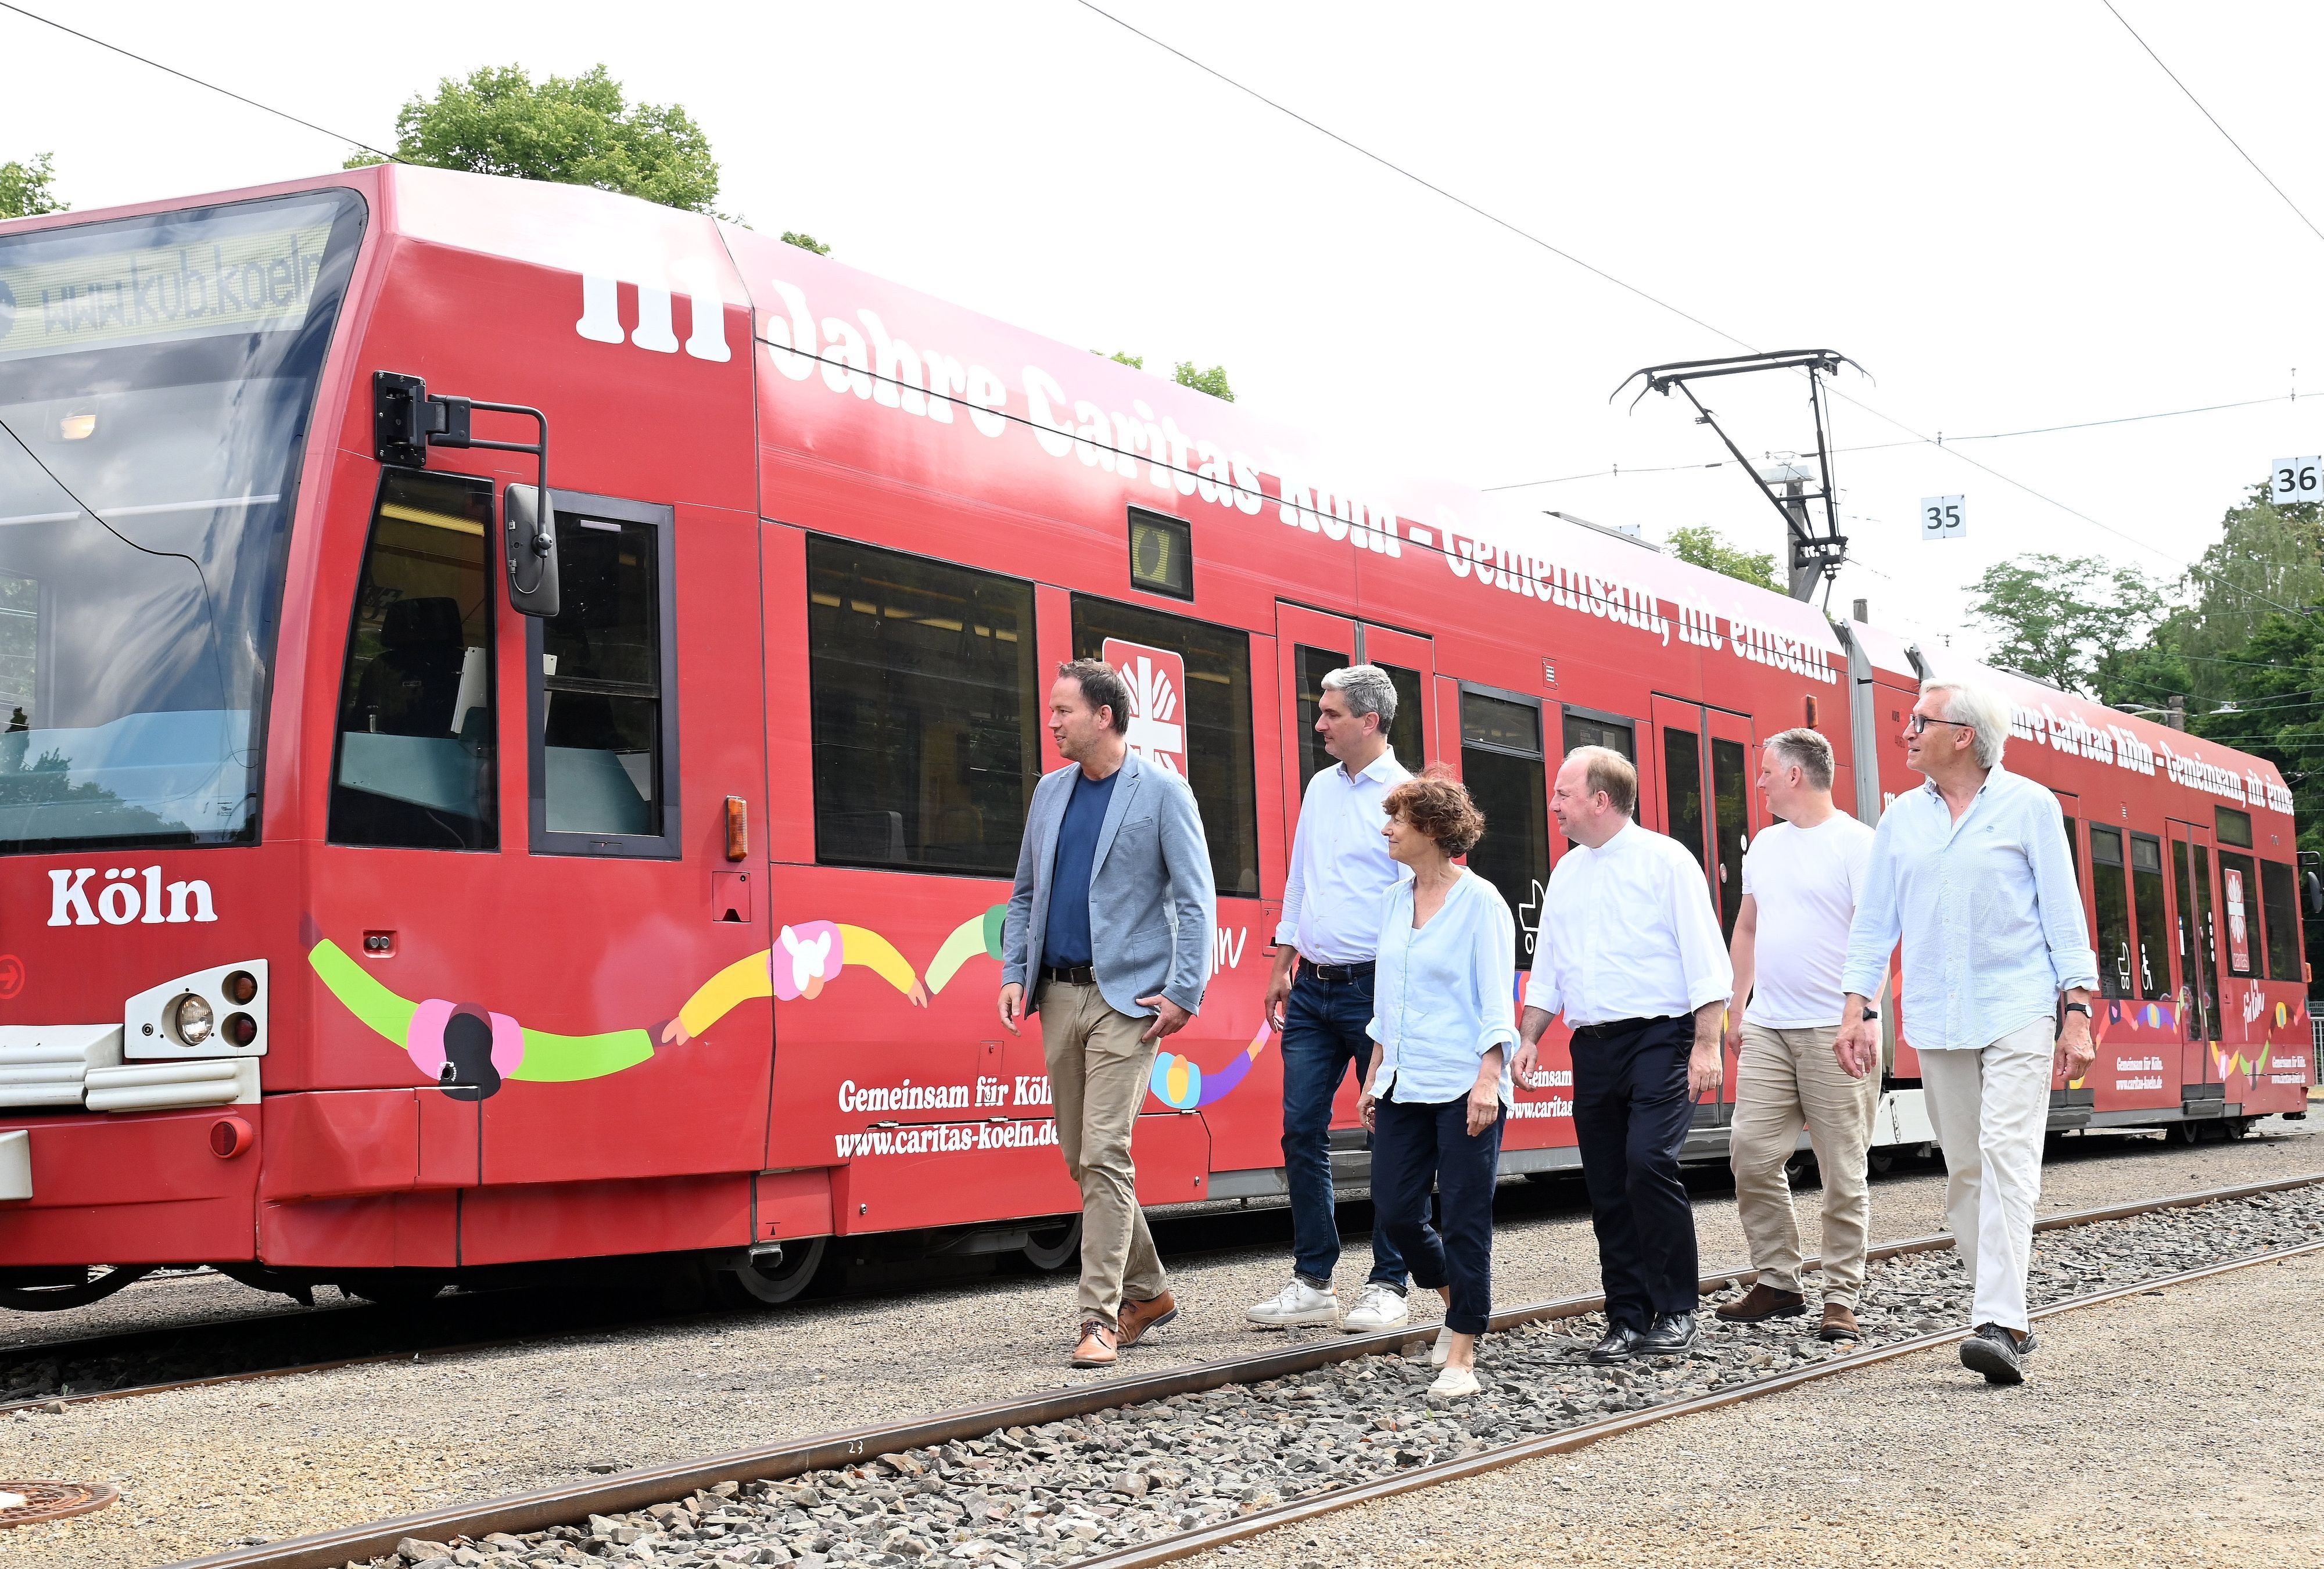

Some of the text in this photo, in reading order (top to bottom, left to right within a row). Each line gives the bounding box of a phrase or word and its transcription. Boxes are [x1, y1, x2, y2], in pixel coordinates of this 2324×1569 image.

[767, 279, 1007, 438] Jahre
[1022, 365, 1262, 515] Caritas
[1438, 505, 1669, 647] Gemeinsam,
[1674, 586, 1723, 651] nit
[1729, 602, 1837, 685] einsam.
[2278, 466, 2317, 493] 36
[1927, 505, 1960, 530] 35
[2041, 702, 2114, 765] Caritas
[2107, 724, 2156, 776] Köln
[2160, 740, 2246, 809] Gemeinsam,
[2246, 769, 2266, 808] nit
[48, 865, 218, 927] Köln
[838, 1078, 969, 1112] Gemeinsam
[974, 1075, 1009, 1107] für
[834, 1119, 1060, 1158] www.caritas-koeln.de
[848, 1440, 863, 1455] 23
